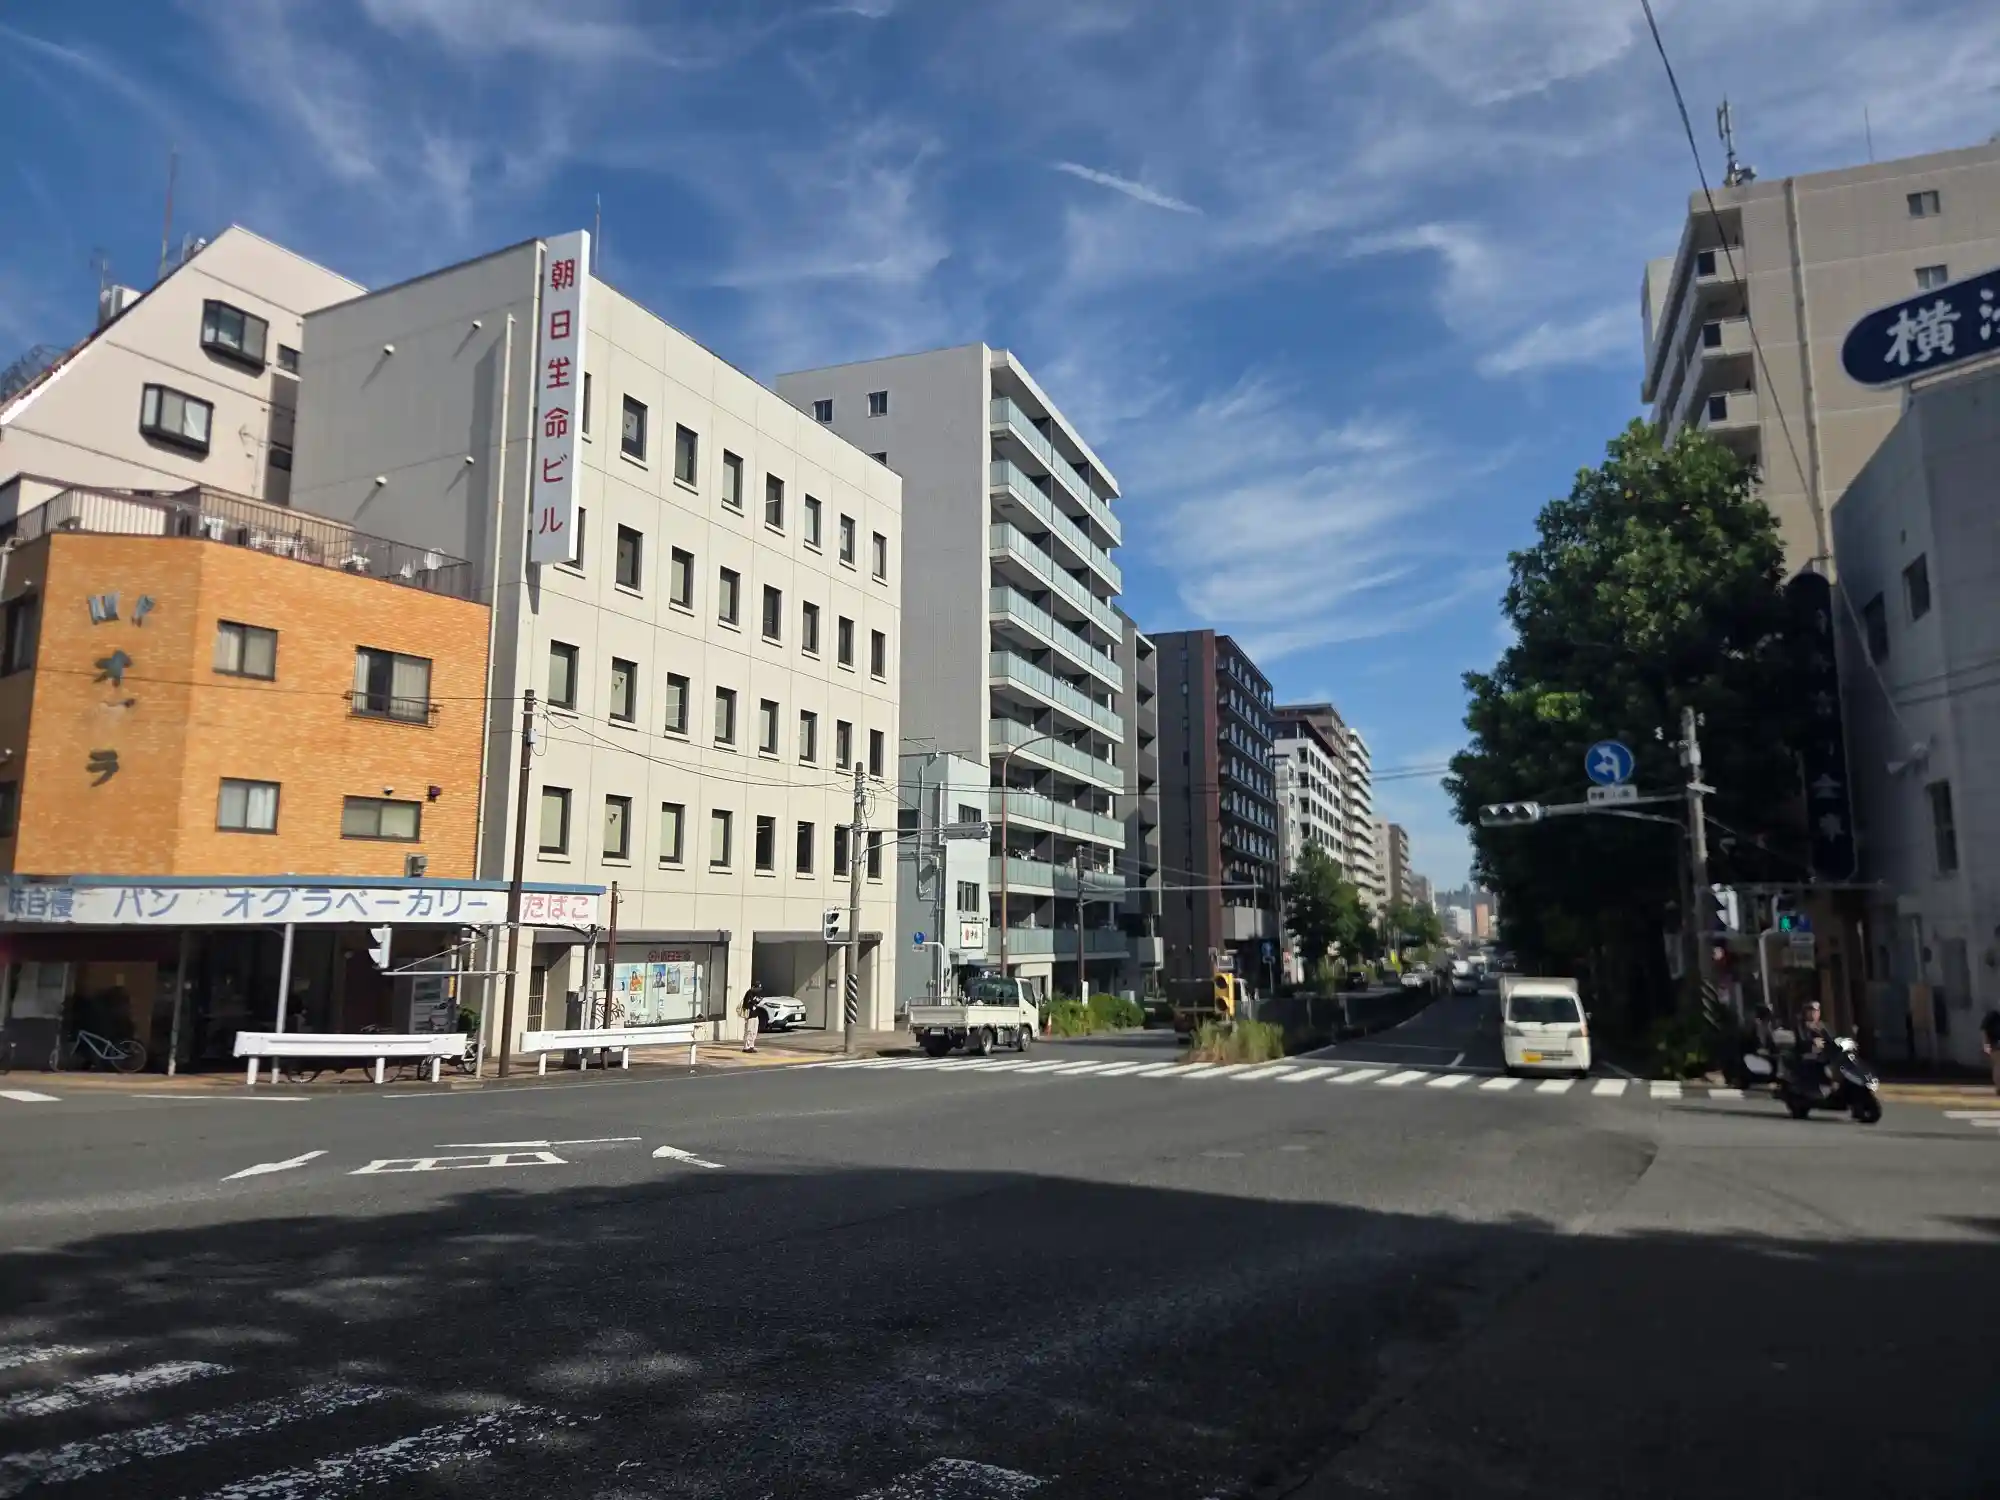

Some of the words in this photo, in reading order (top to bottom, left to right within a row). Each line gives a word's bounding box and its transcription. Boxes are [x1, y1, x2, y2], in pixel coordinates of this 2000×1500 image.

[539, 258, 575, 535] 朝日生命ビル
[113, 888, 179, 918] パン
[221, 888, 488, 919] オグラベーカリー
[523, 893, 590, 920] たばこ
